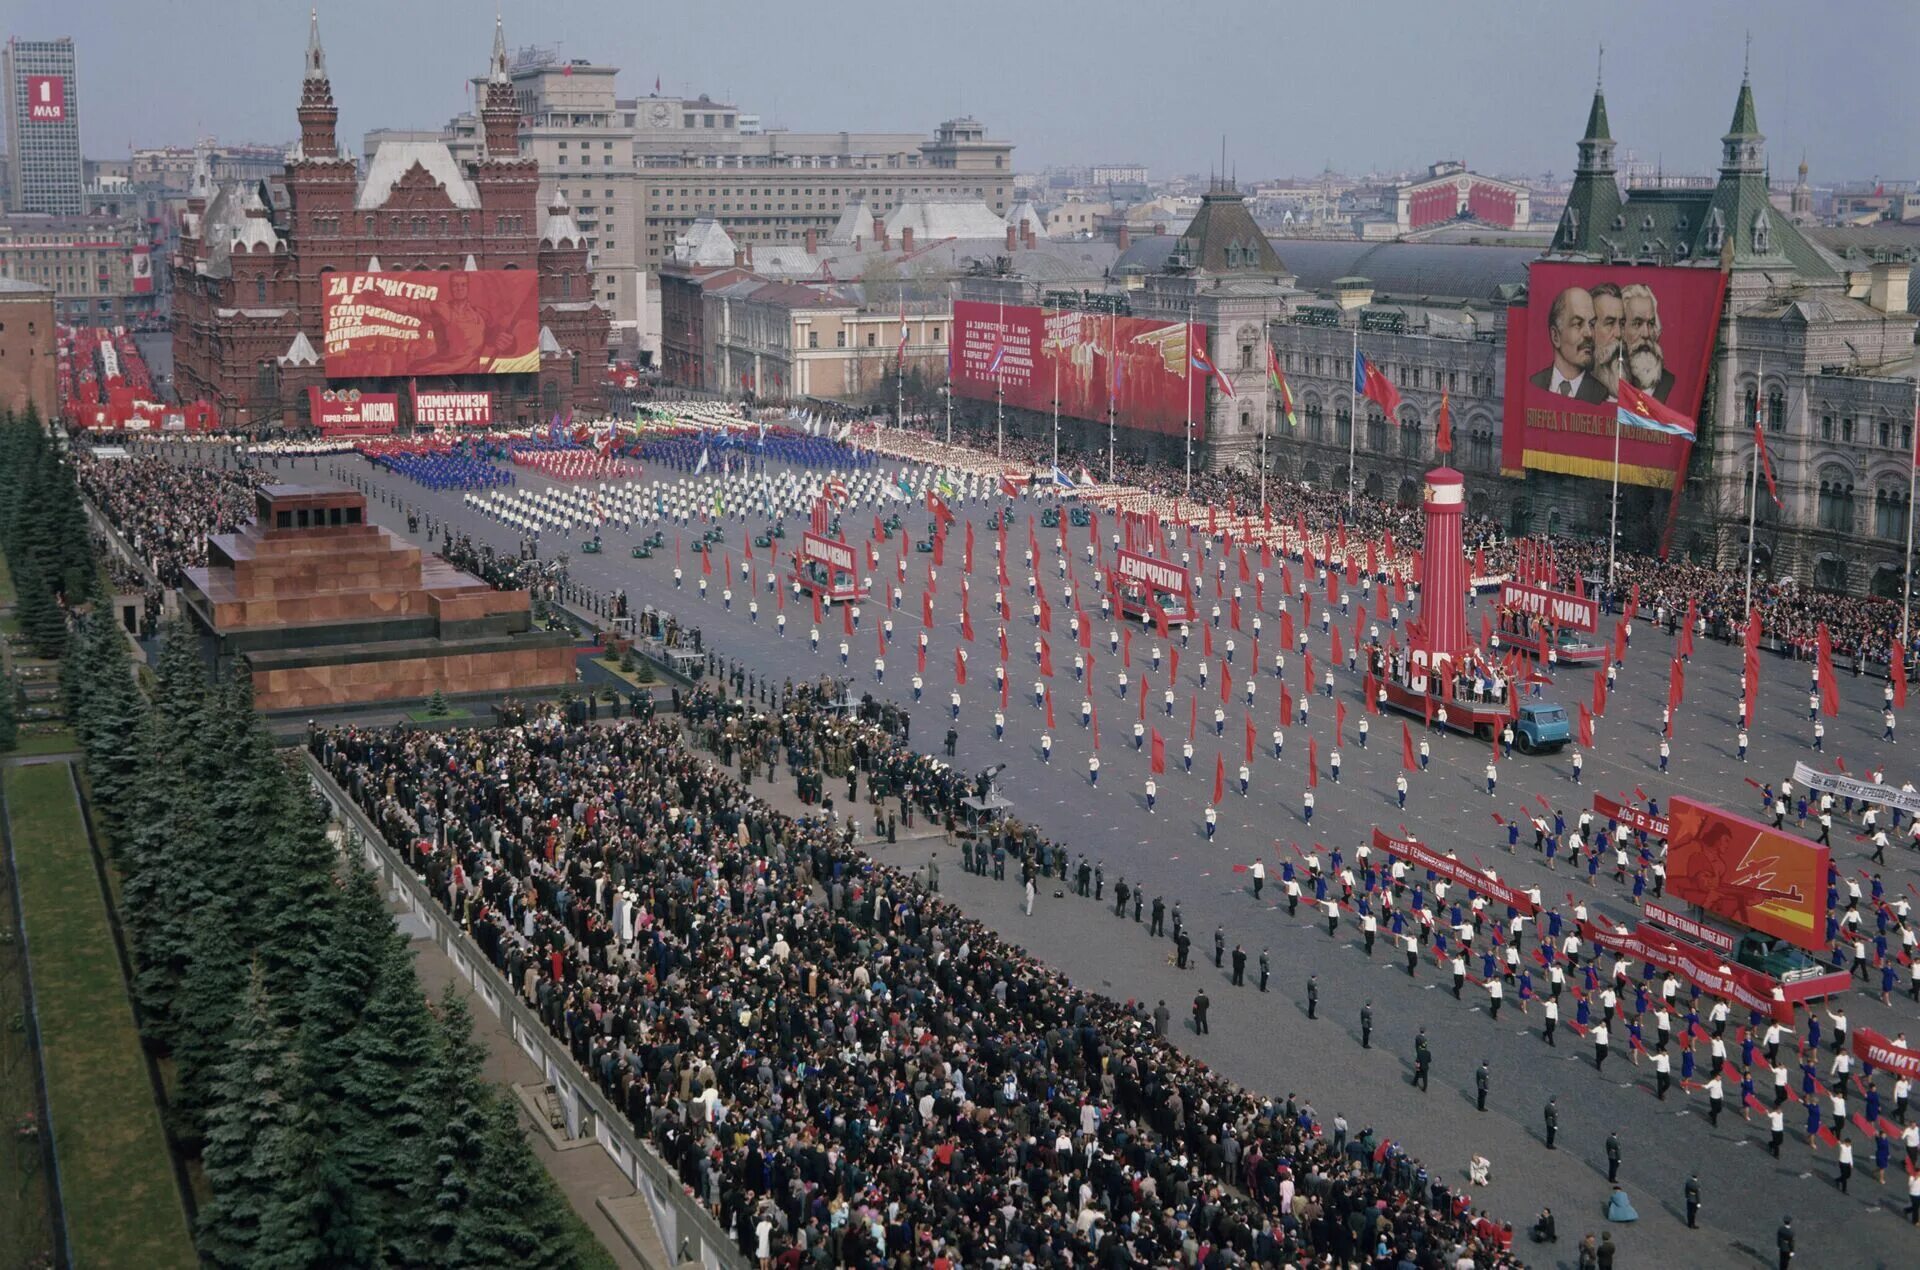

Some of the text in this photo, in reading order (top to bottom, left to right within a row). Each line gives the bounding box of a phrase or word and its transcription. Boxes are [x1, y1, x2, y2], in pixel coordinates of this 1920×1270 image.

[40, 81, 50, 102] 1
[34, 105, 61, 117] МАЯ
[328, 277, 348, 296] ЗА
[341, 295, 354, 304] И
[329, 316, 363, 330] ВСЕХ
[330, 305, 421, 327] СПЛОЧЕННОСТЬ
[417, 394, 489, 408] КОММУНИЗМ
[322, 403, 395, 423] ГОРОД-ГЕРОЙ МОСКВА
[417, 408, 489, 422] ПОБЕДИТ!
[1560, 410, 1568, 431] К
[1570, 412, 1603, 435] ПОБЕДЕ
[805, 537, 852, 570] СОЦИАЛИЗМА
[1120, 555, 1182, 591] ДЕМОКРАТИИ
[1551, 598, 1591, 627] МИРА
[1618, 807, 1635, 822] МЫ
[1637, 815, 1645, 826] С
[1389, 840, 1408, 854] СЛАВА
[1645, 904, 1666, 923] НАРОД
[1667, 914, 1700, 936] ВЬЕТНАМА
